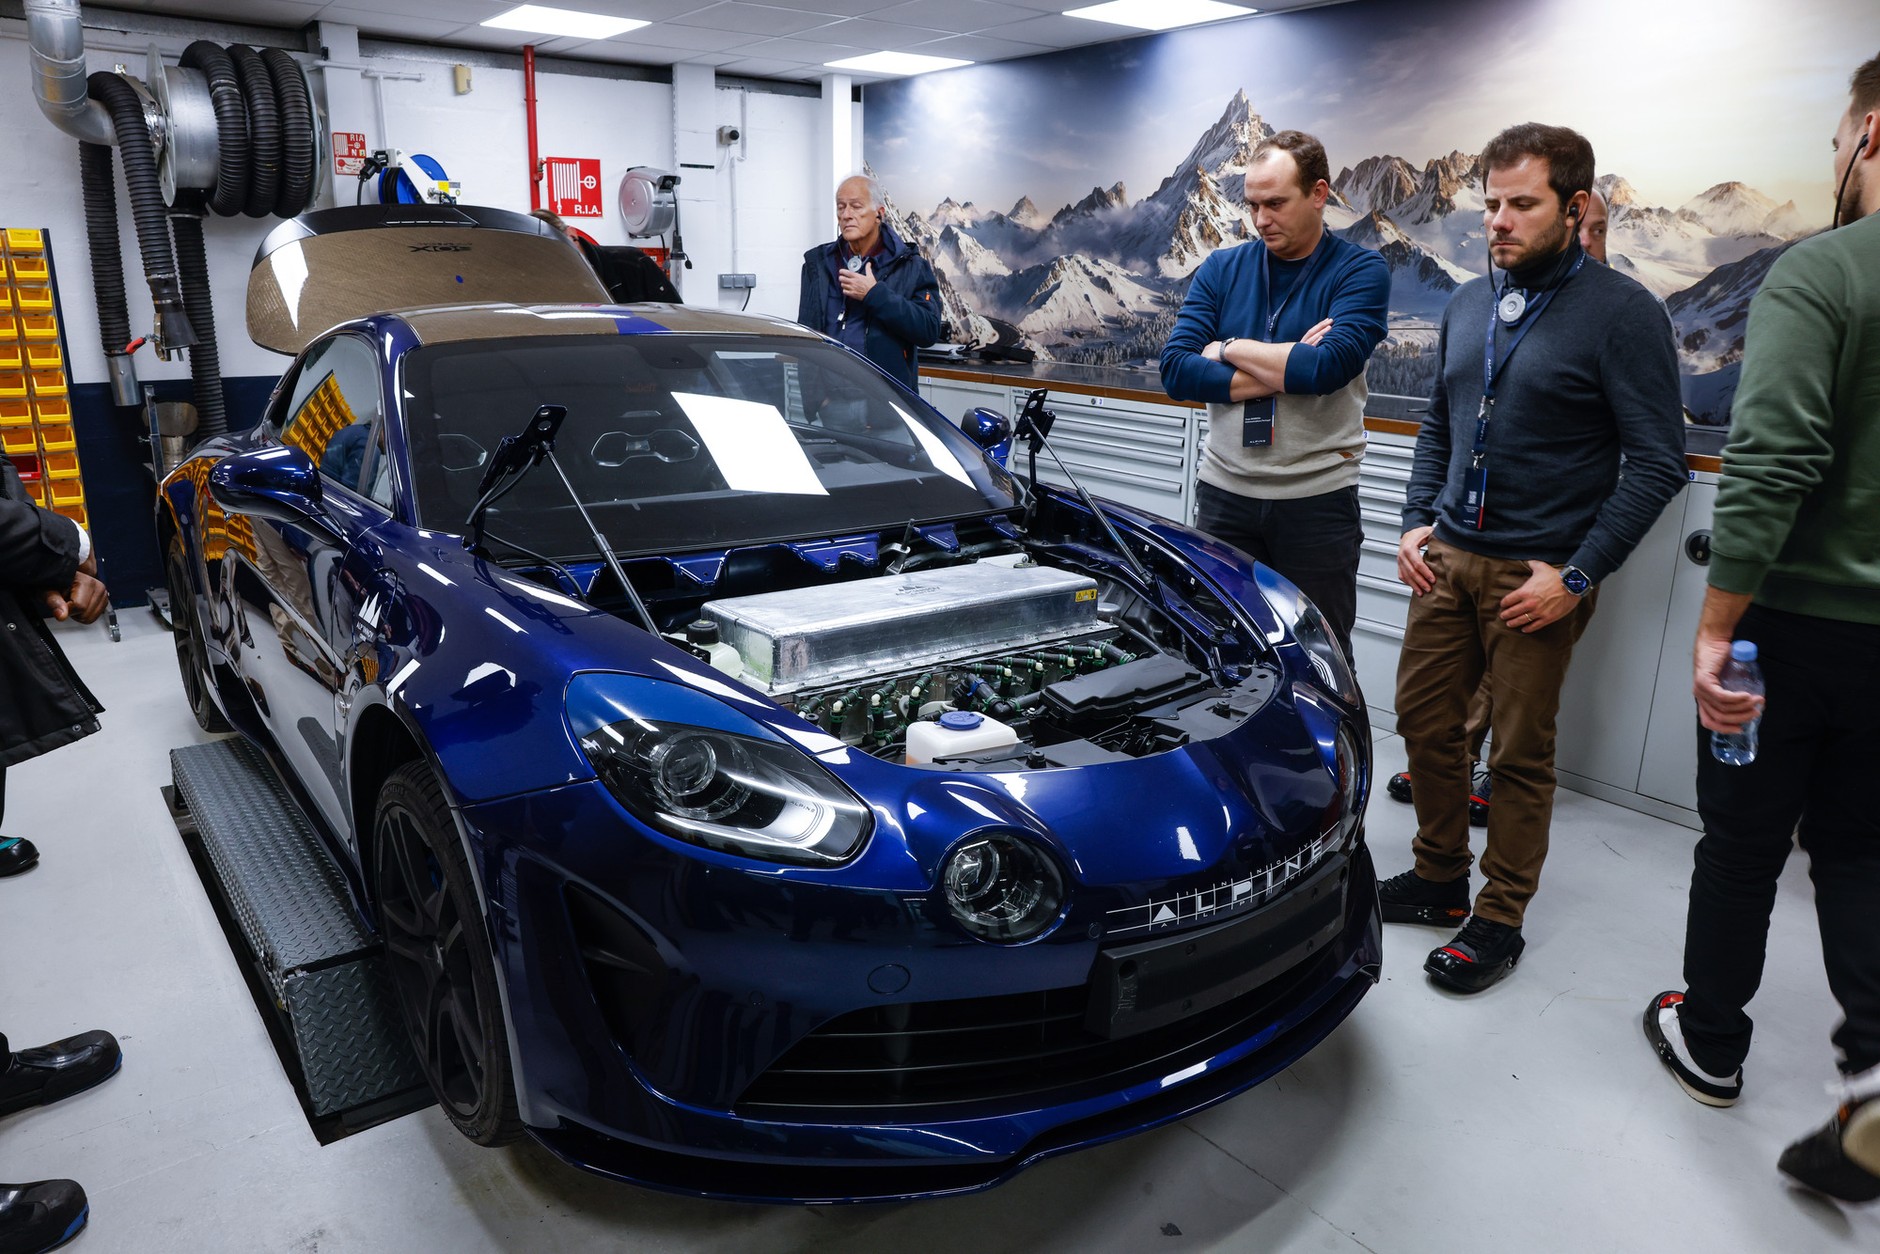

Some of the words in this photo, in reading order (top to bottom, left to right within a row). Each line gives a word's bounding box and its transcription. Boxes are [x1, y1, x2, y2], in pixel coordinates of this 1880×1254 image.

[350, 134, 365, 142] RIA
[574, 204, 602, 215] R.I.A.
[1689, 471, 1696, 481] 3
[1151, 839, 1323, 923] ALPINE
